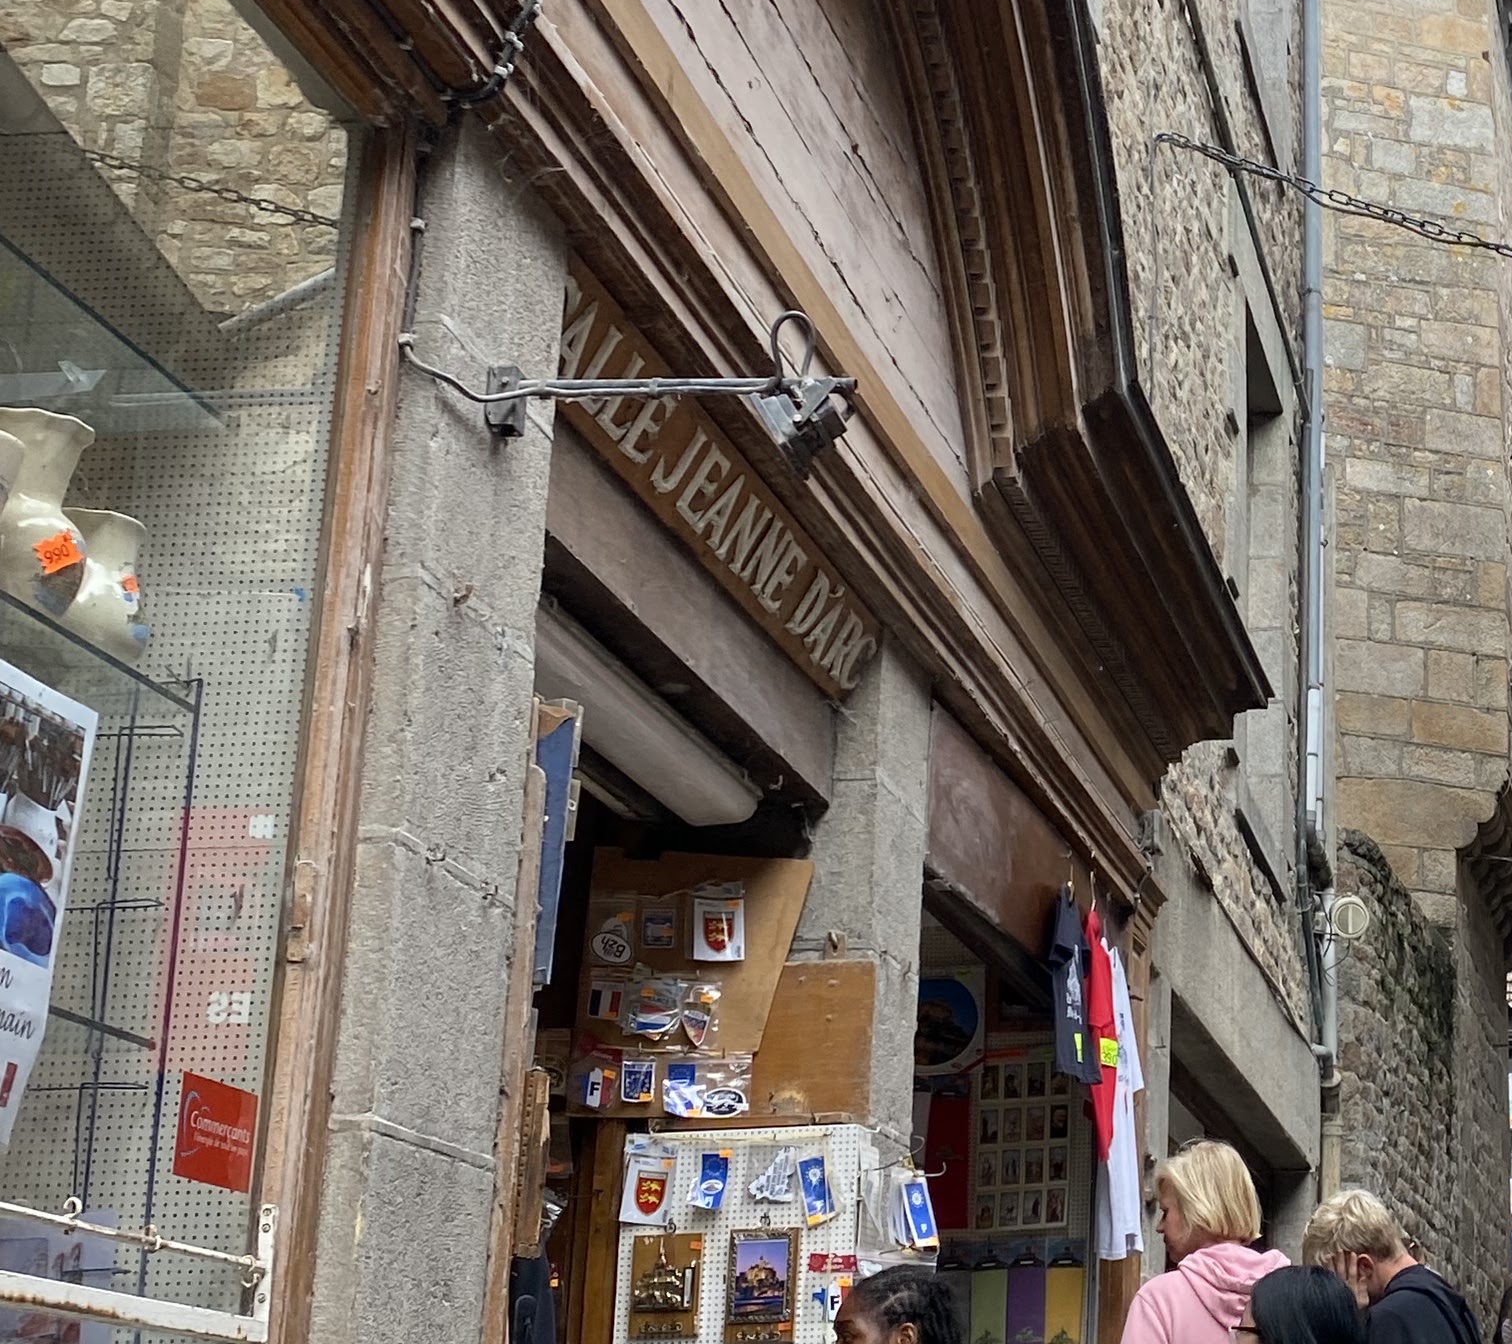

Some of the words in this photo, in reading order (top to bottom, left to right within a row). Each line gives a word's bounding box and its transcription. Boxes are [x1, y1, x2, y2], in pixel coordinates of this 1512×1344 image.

[557, 275, 679, 464] ALLE
[650, 426, 808, 616] JEANNE
[784, 568, 878, 690] D'ARC
[590, 1082, 600, 1096] F
[830, 1295, 841, 1311] F
